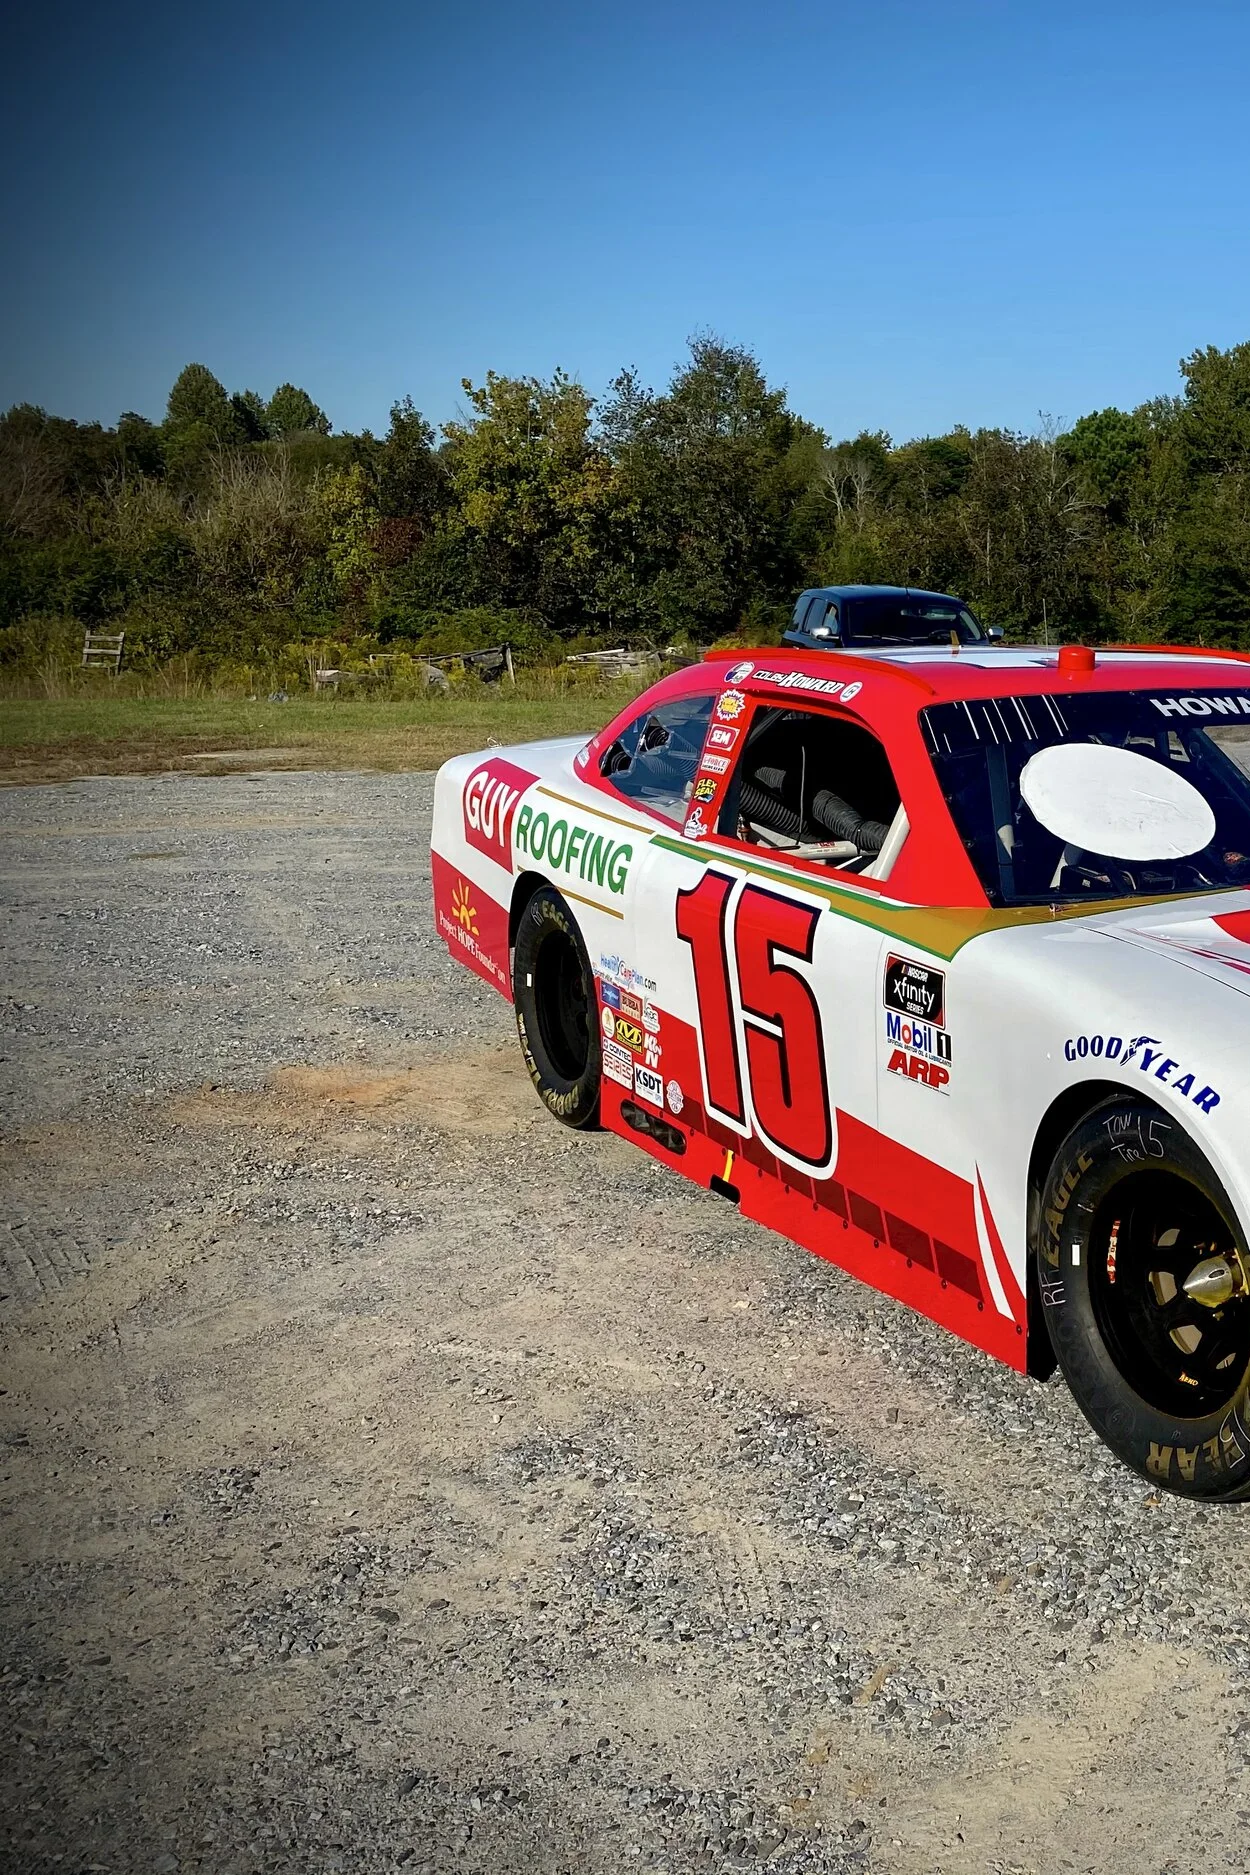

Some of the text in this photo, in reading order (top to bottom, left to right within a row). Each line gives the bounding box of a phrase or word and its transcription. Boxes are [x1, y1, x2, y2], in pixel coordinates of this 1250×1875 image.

[778, 672, 846, 693] HOWARD
[711, 730, 731, 745] SEM
[695, 787, 713, 795] SEAL
[697, 778, 717, 790] FLEX
[465, 771, 633, 895] GUY ROOFING
[440, 910, 457, 939] Project
[457, 926, 475, 956] HOPE
[907, 966, 929, 982] NASCAR
[894, 977, 935, 1012] xfinity
[675, 867, 834, 1169] 15
[906, 1001, 925, 1016] SERIES
[886, 1012, 932, 1053] Mobil
[635, 1066, 661, 1093] KSDT
[887, 1049, 950, 1089] ARP
[1138, 1115, 1172, 1158] 15
[1111, 1143, 1145, 1163] Tire
